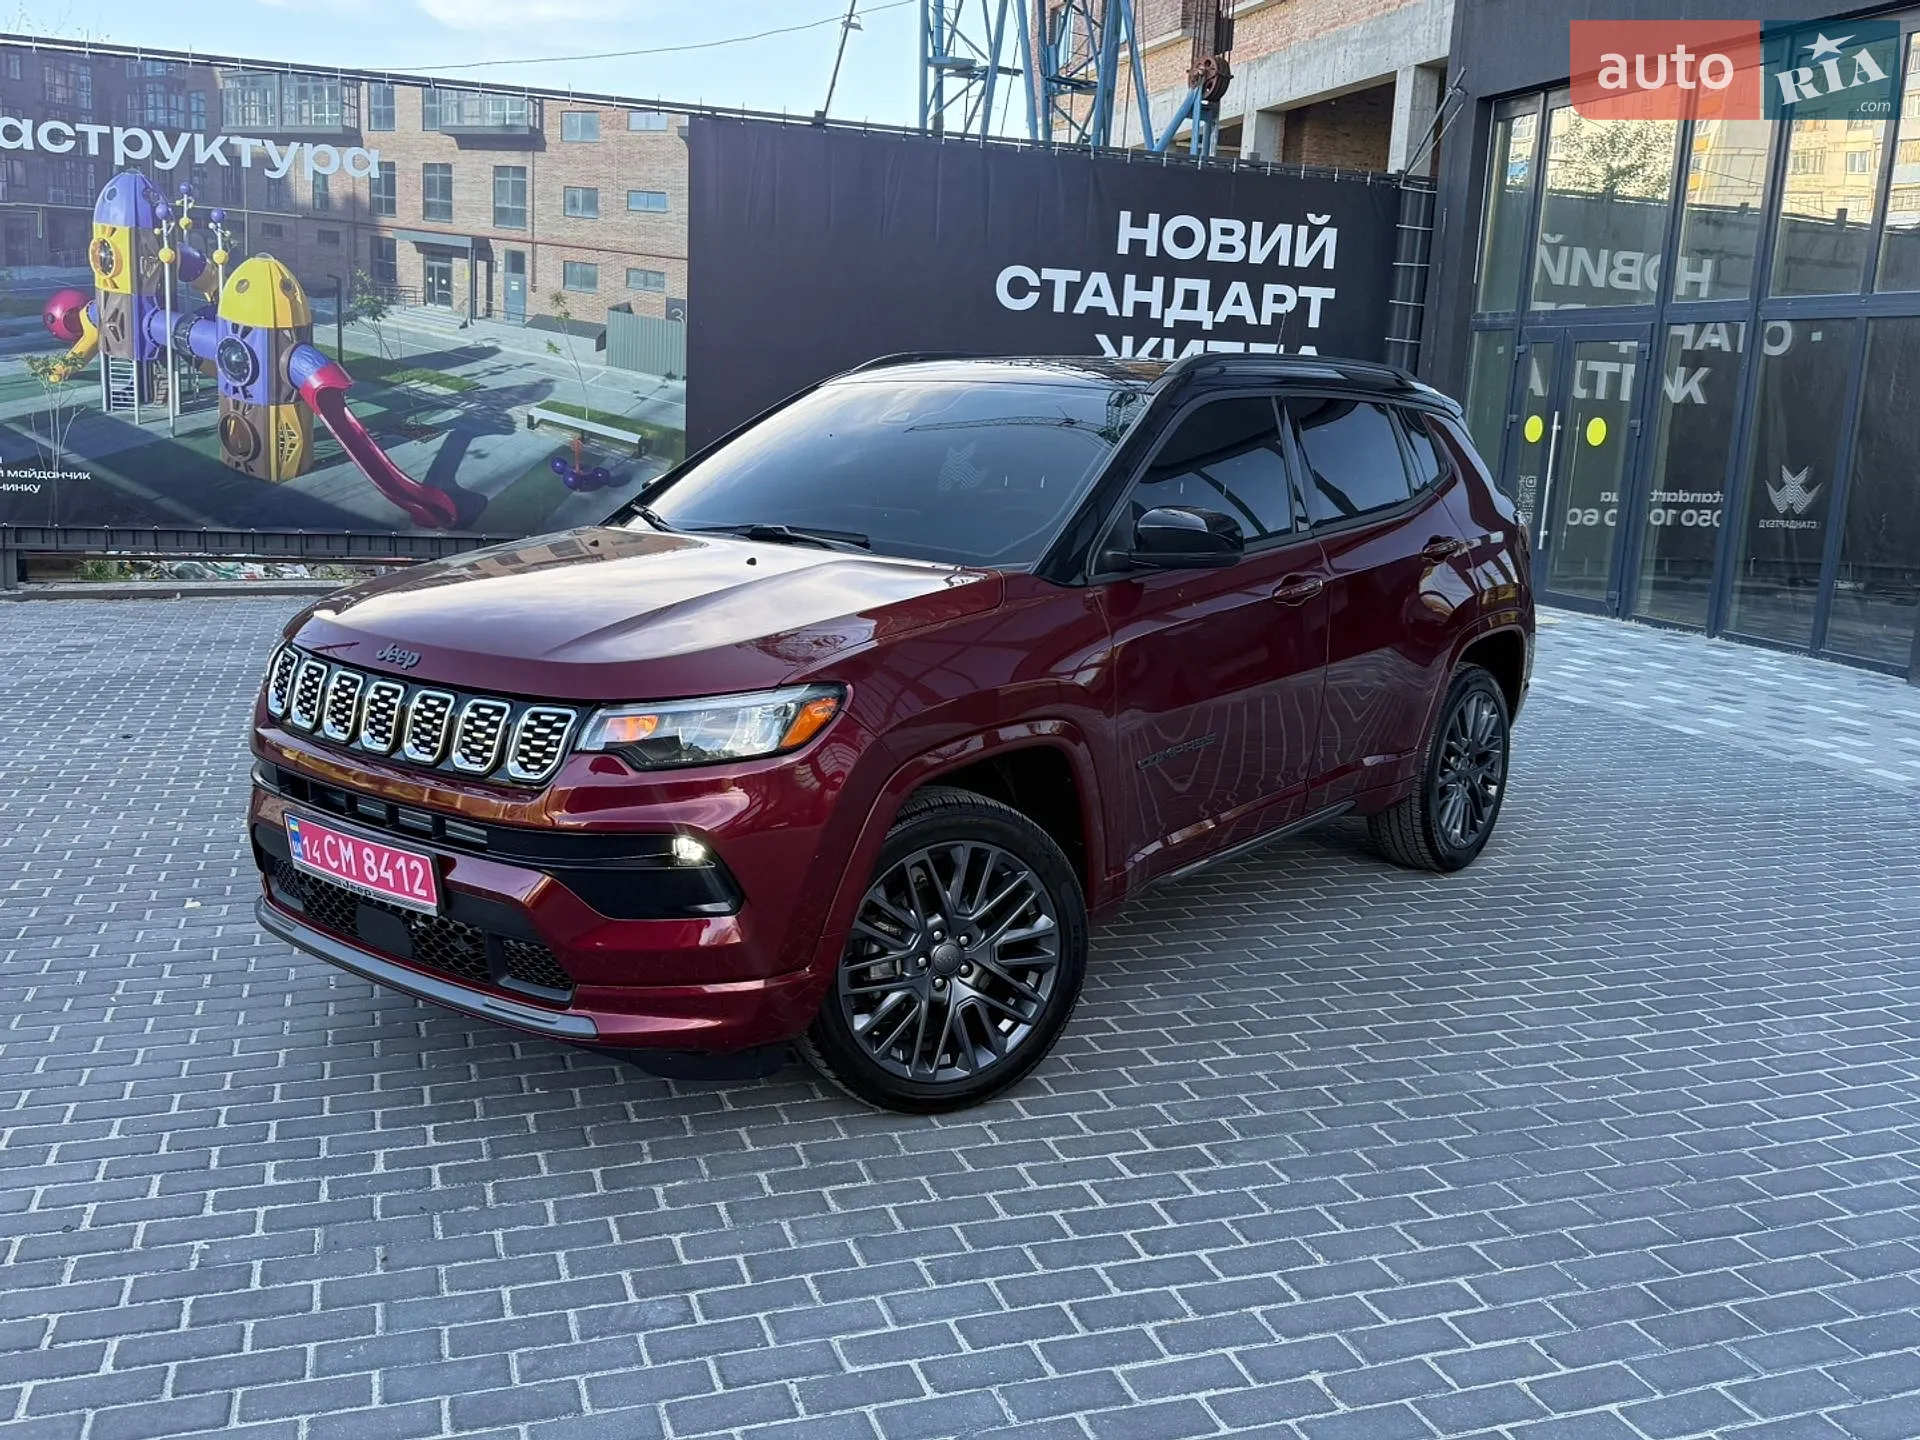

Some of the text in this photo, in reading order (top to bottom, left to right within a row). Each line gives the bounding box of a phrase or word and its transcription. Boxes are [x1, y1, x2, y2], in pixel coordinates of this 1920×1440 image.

[0, 116, 380, 179] аструктура
[1117, 210, 1338, 269] НОВИЙ
[996, 265, 1336, 331] СТАНДАРТ
[7, 468, 91, 480] майданчик
[375, 643, 421, 670] Jeep
[362, 847, 428, 897] 8412
